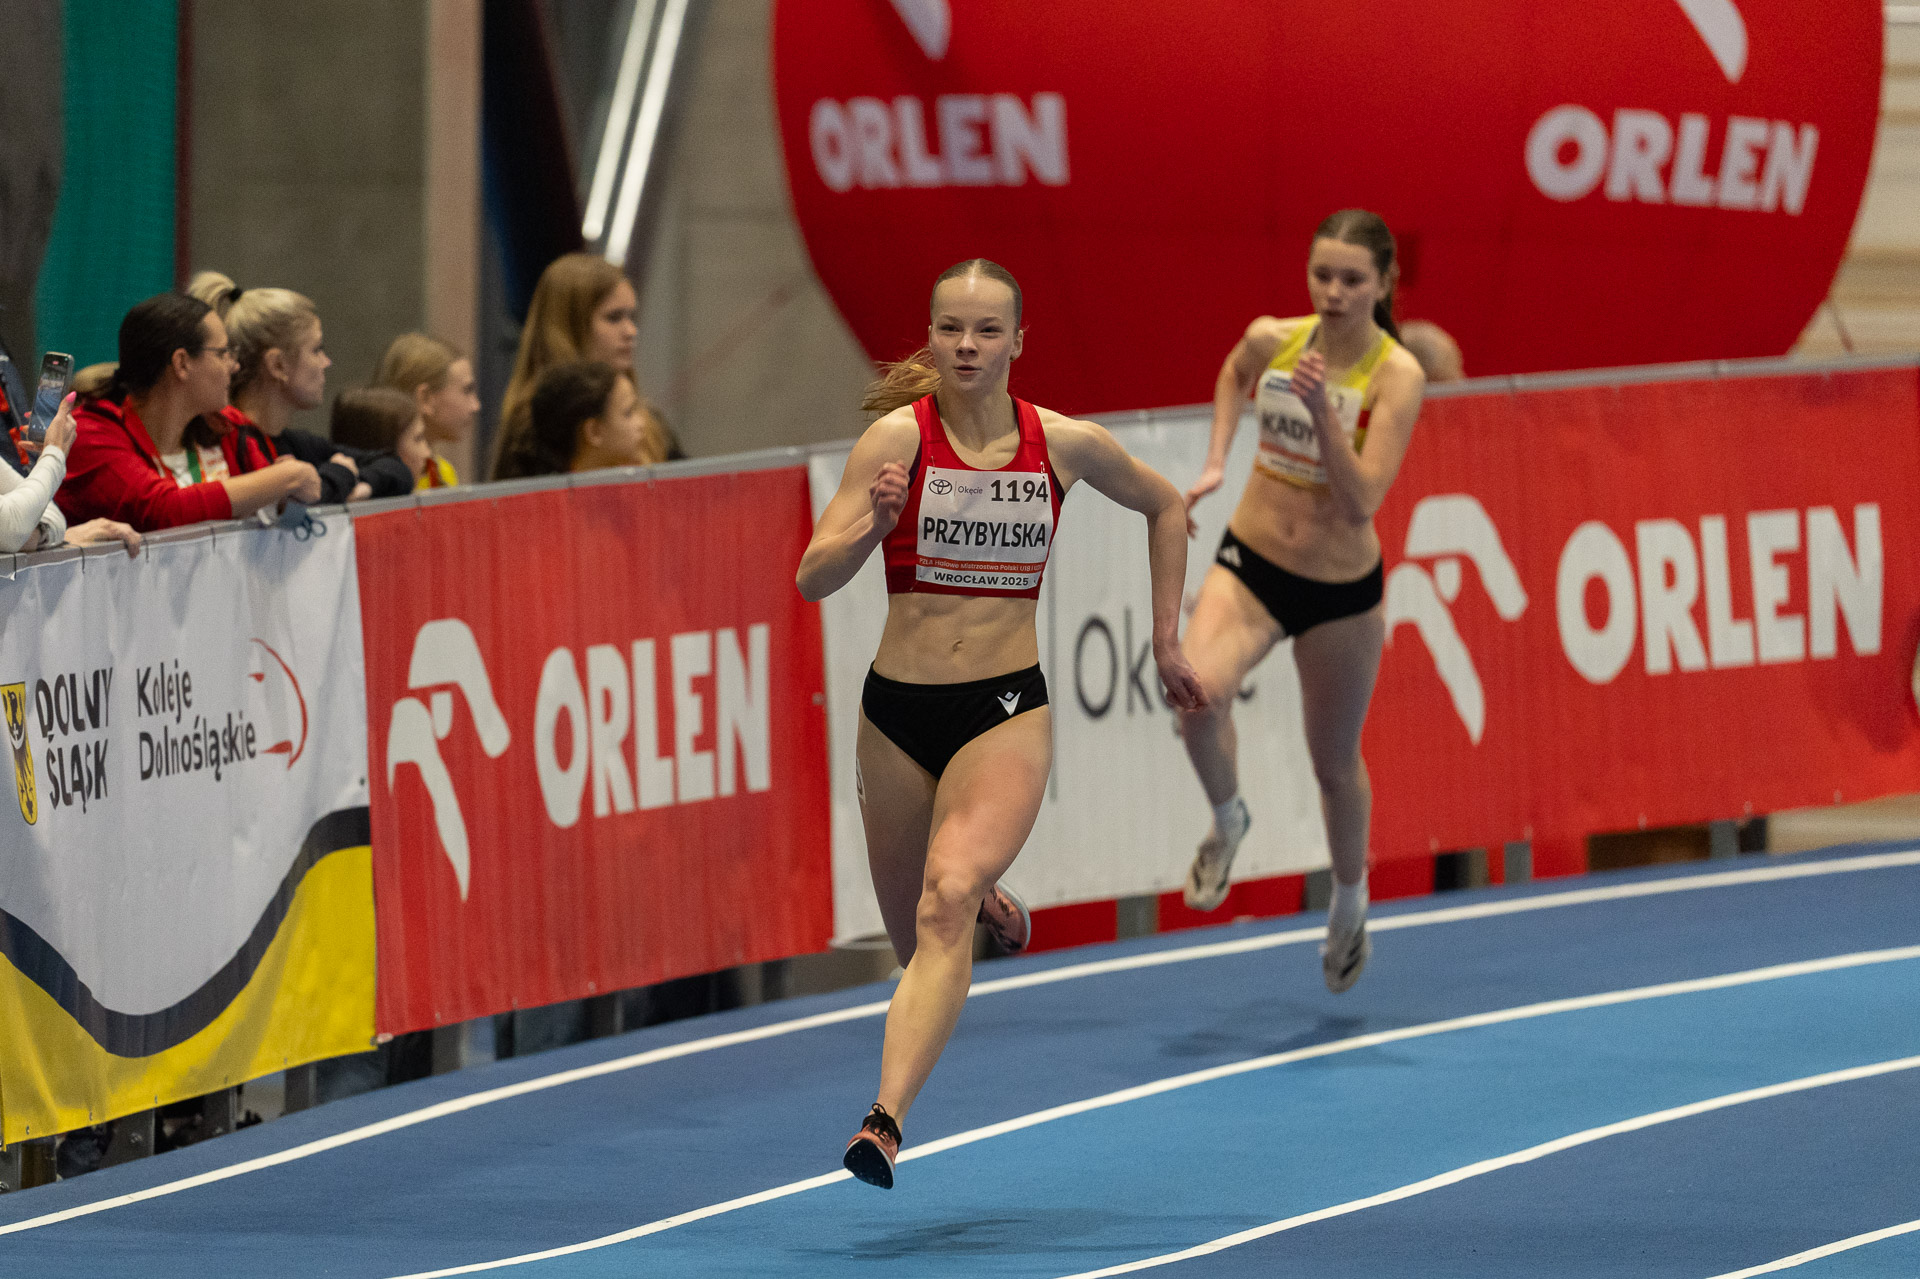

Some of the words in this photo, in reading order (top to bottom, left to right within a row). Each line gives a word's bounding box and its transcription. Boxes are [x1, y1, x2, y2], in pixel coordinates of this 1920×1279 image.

[808, 91, 1070, 193] ORLEN
[1524, 103, 1820, 216] ORLEN
[1262, 411, 1314, 442] KADY
[957, 485, 984, 496] Okęcie
[990, 479, 1049, 502] 1194
[919, 557, 933, 565] PZLA
[934, 559, 959, 569] Halowe
[960, 563, 999, 571] Mistrzostwa
[923, 516, 1046, 548] PRZYBYLSKA
[934, 571, 999, 585] WROCŁAW
[1001, 576, 1029, 586] 2025
[1556, 502, 1884, 685] ORLEN
[35, 667, 113, 738] DOLNY
[136, 658, 192, 723] Koleje
[138, 710, 256, 782] Dolnośląskie
[534, 622, 771, 828] ORLEN
[46, 734, 108, 814] ŚLĄSK
